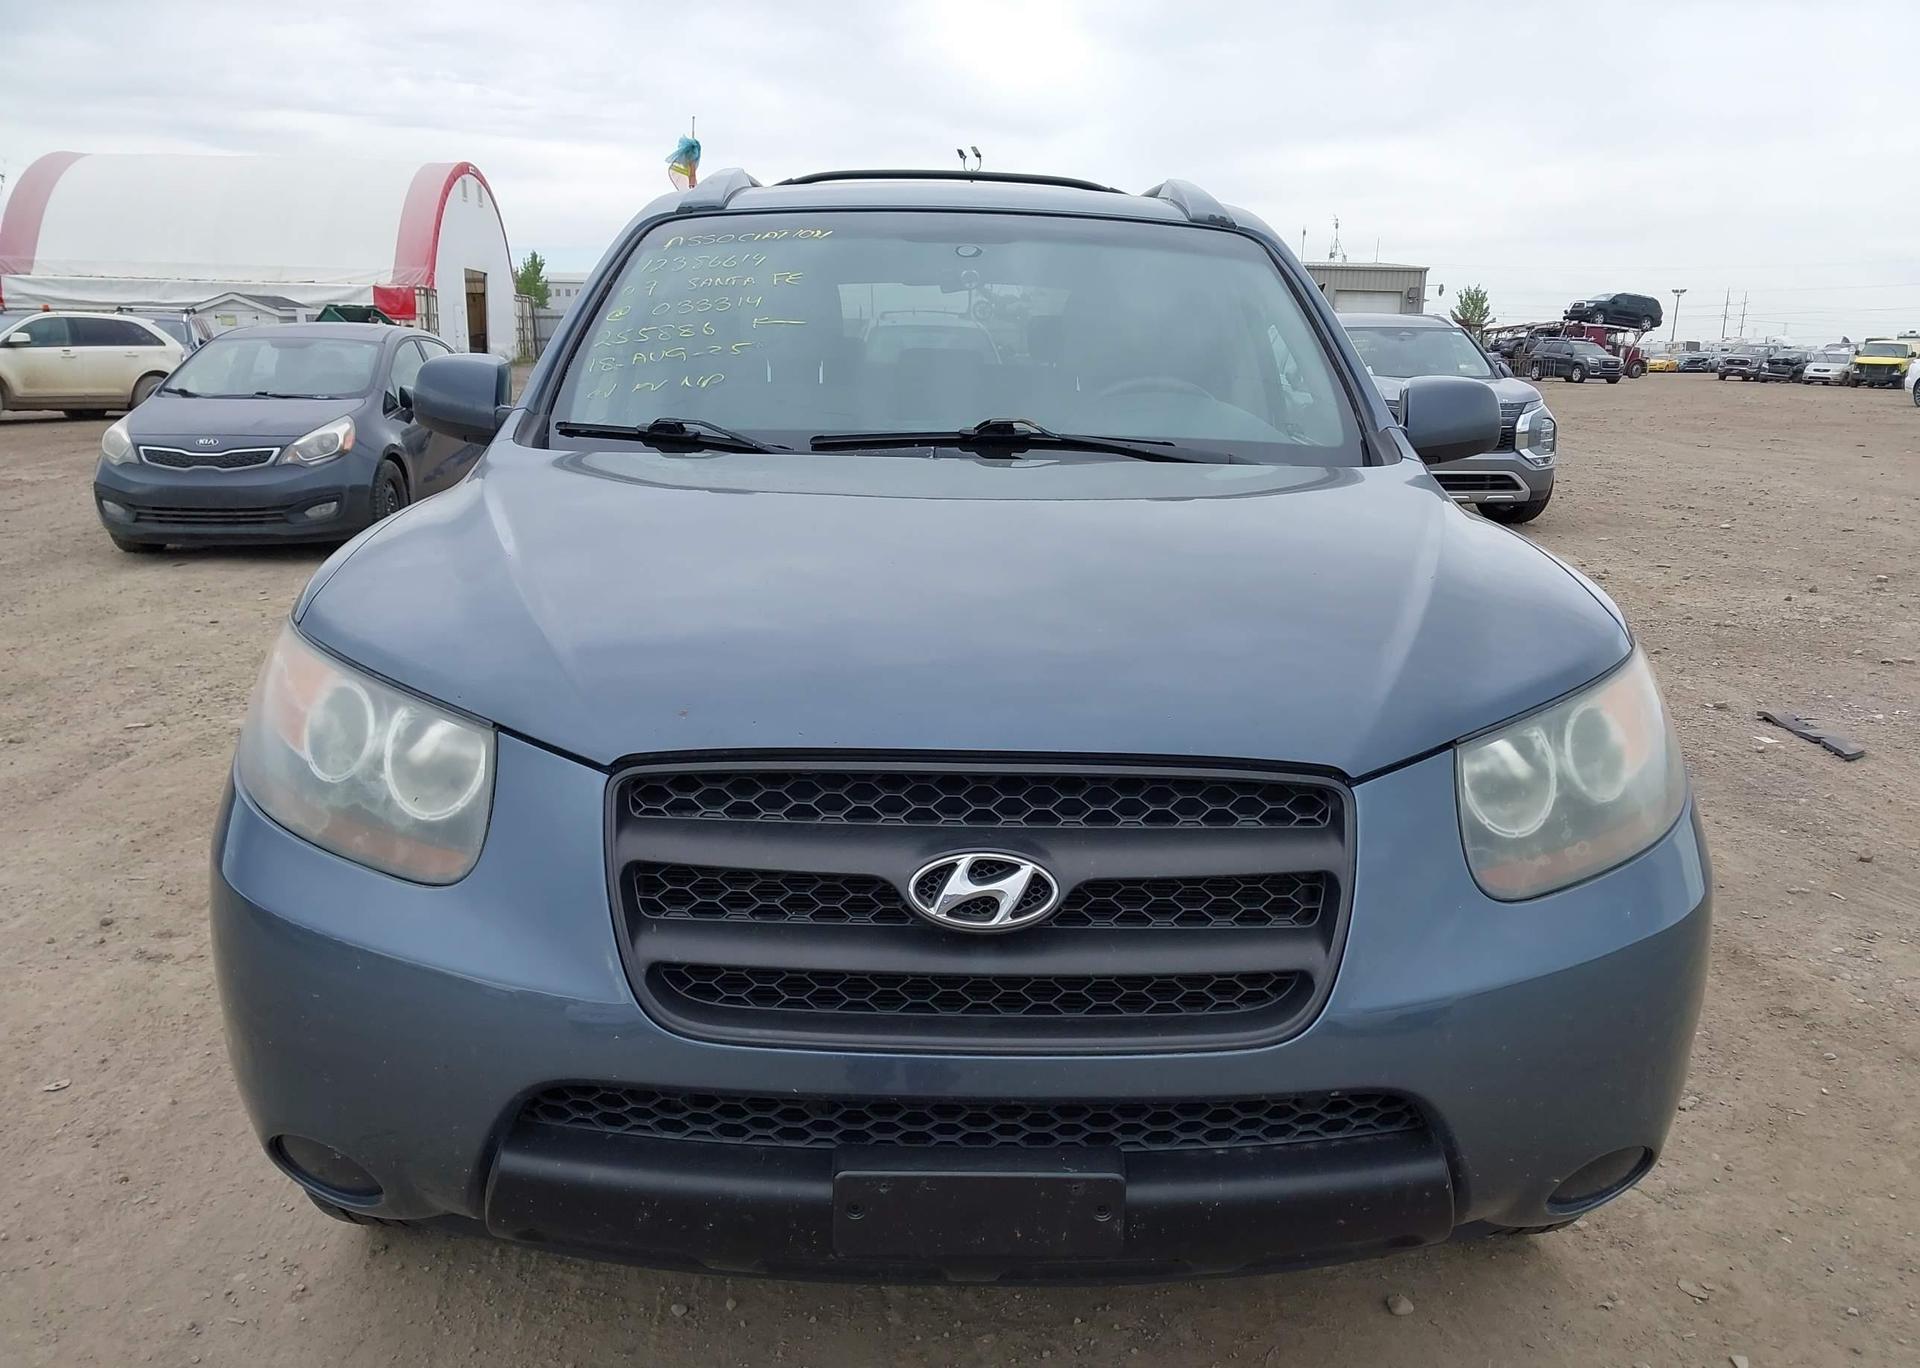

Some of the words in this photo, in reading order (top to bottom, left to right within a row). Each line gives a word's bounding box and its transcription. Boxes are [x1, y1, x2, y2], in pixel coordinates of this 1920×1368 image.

[687, 276, 757, 290] SANTA
[773, 271, 804, 286] FE
[651, 296, 763, 317] 033314
[594, 321, 716, 348] 255886
